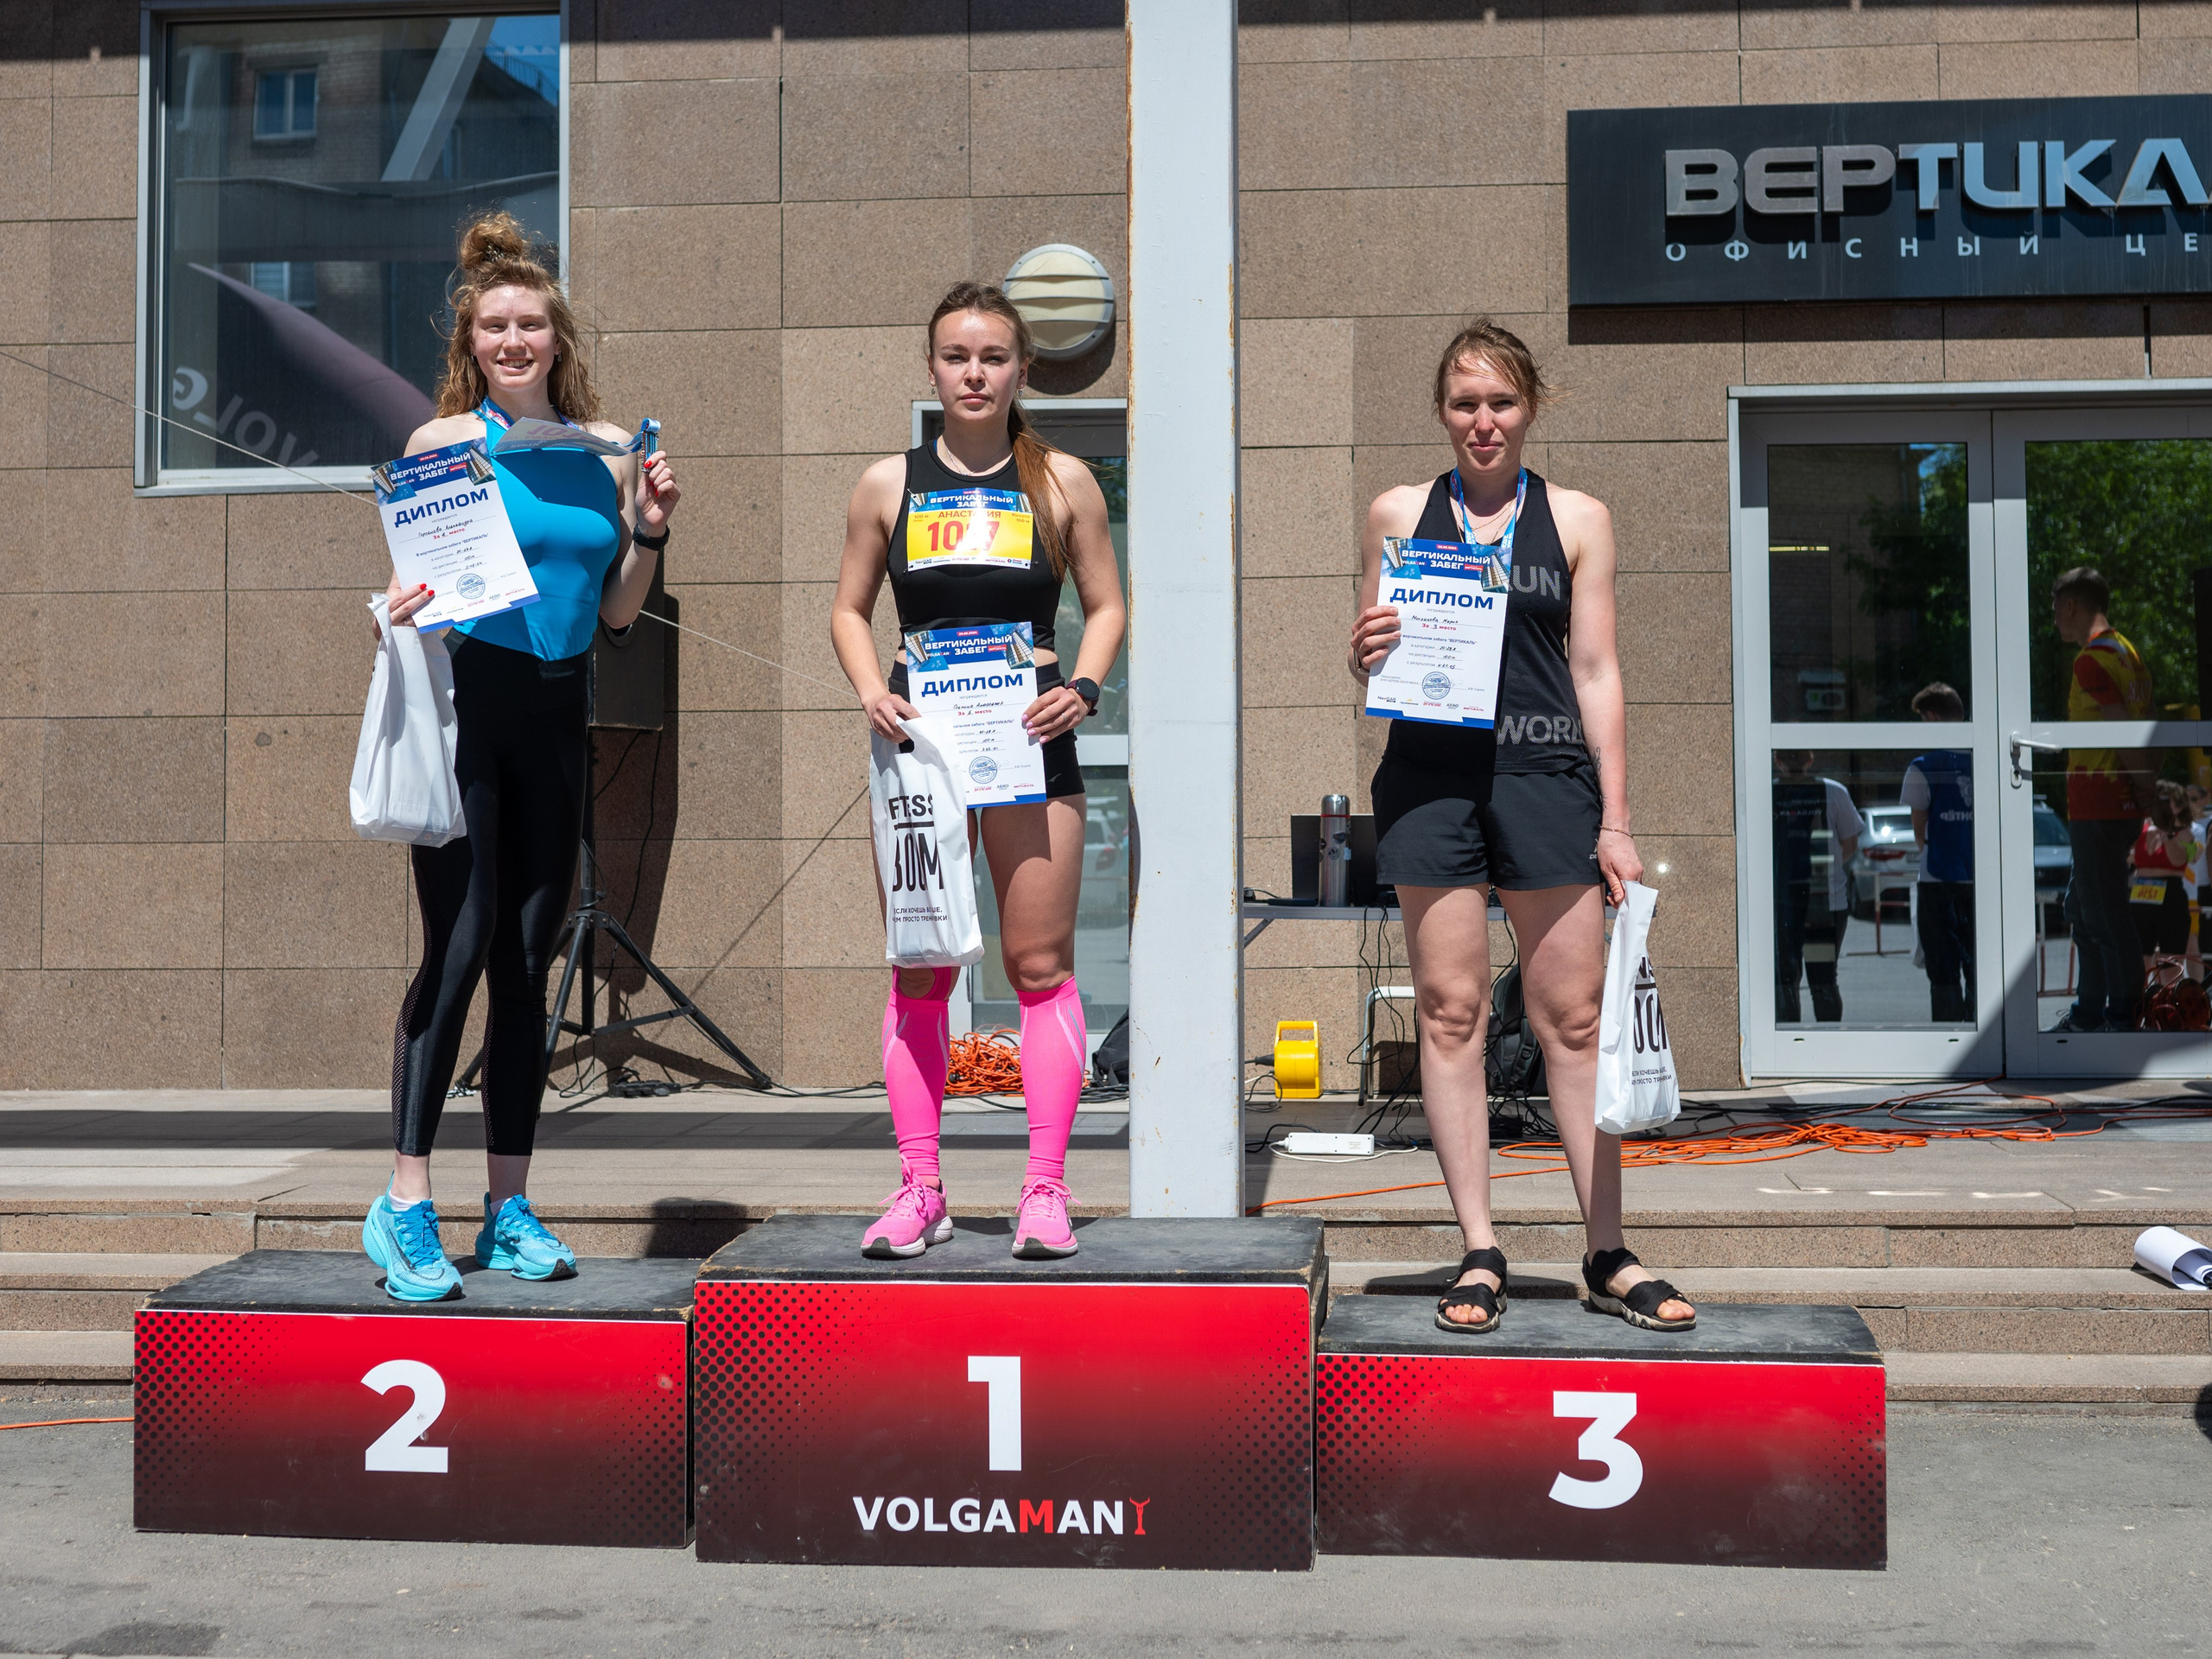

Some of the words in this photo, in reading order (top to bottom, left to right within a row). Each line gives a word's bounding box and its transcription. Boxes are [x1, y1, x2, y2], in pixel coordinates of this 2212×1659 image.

[1664, 138, 2212, 218] ВЕРТИКА
[390, 452, 472, 481] ВЕРТИКАЛЬНЫЙ
[418, 467, 449, 481] ЗАБЕГ
[394, 487, 490, 528] ДИПЛОМ
[930, 493, 1014, 504] ВЕРТИКАЛЬНЫЙ
[938, 510, 1001, 518] АНАСТИЯ
[927, 520, 1000, 552] 107
[1402, 550, 1491, 564] ВЕРТИКАЛЬНЫЙ
[1430, 560, 1464, 570] ЗАБЕГ
[1389, 588, 1494, 610] ДИПЛОМ
[925, 635, 1013, 650] ВЕРТИКАЛЬНЫЙ
[954, 645, 988, 656] ЗАБЕГ
[921, 673, 1024, 698] ДИПЛОМ
[360, 1359, 448, 1473] 2
[968, 1356, 1021, 1471] 1
[1548, 1390, 1643, 1510] 3
[853, 1496, 1123, 1535] VOLGAMAN
